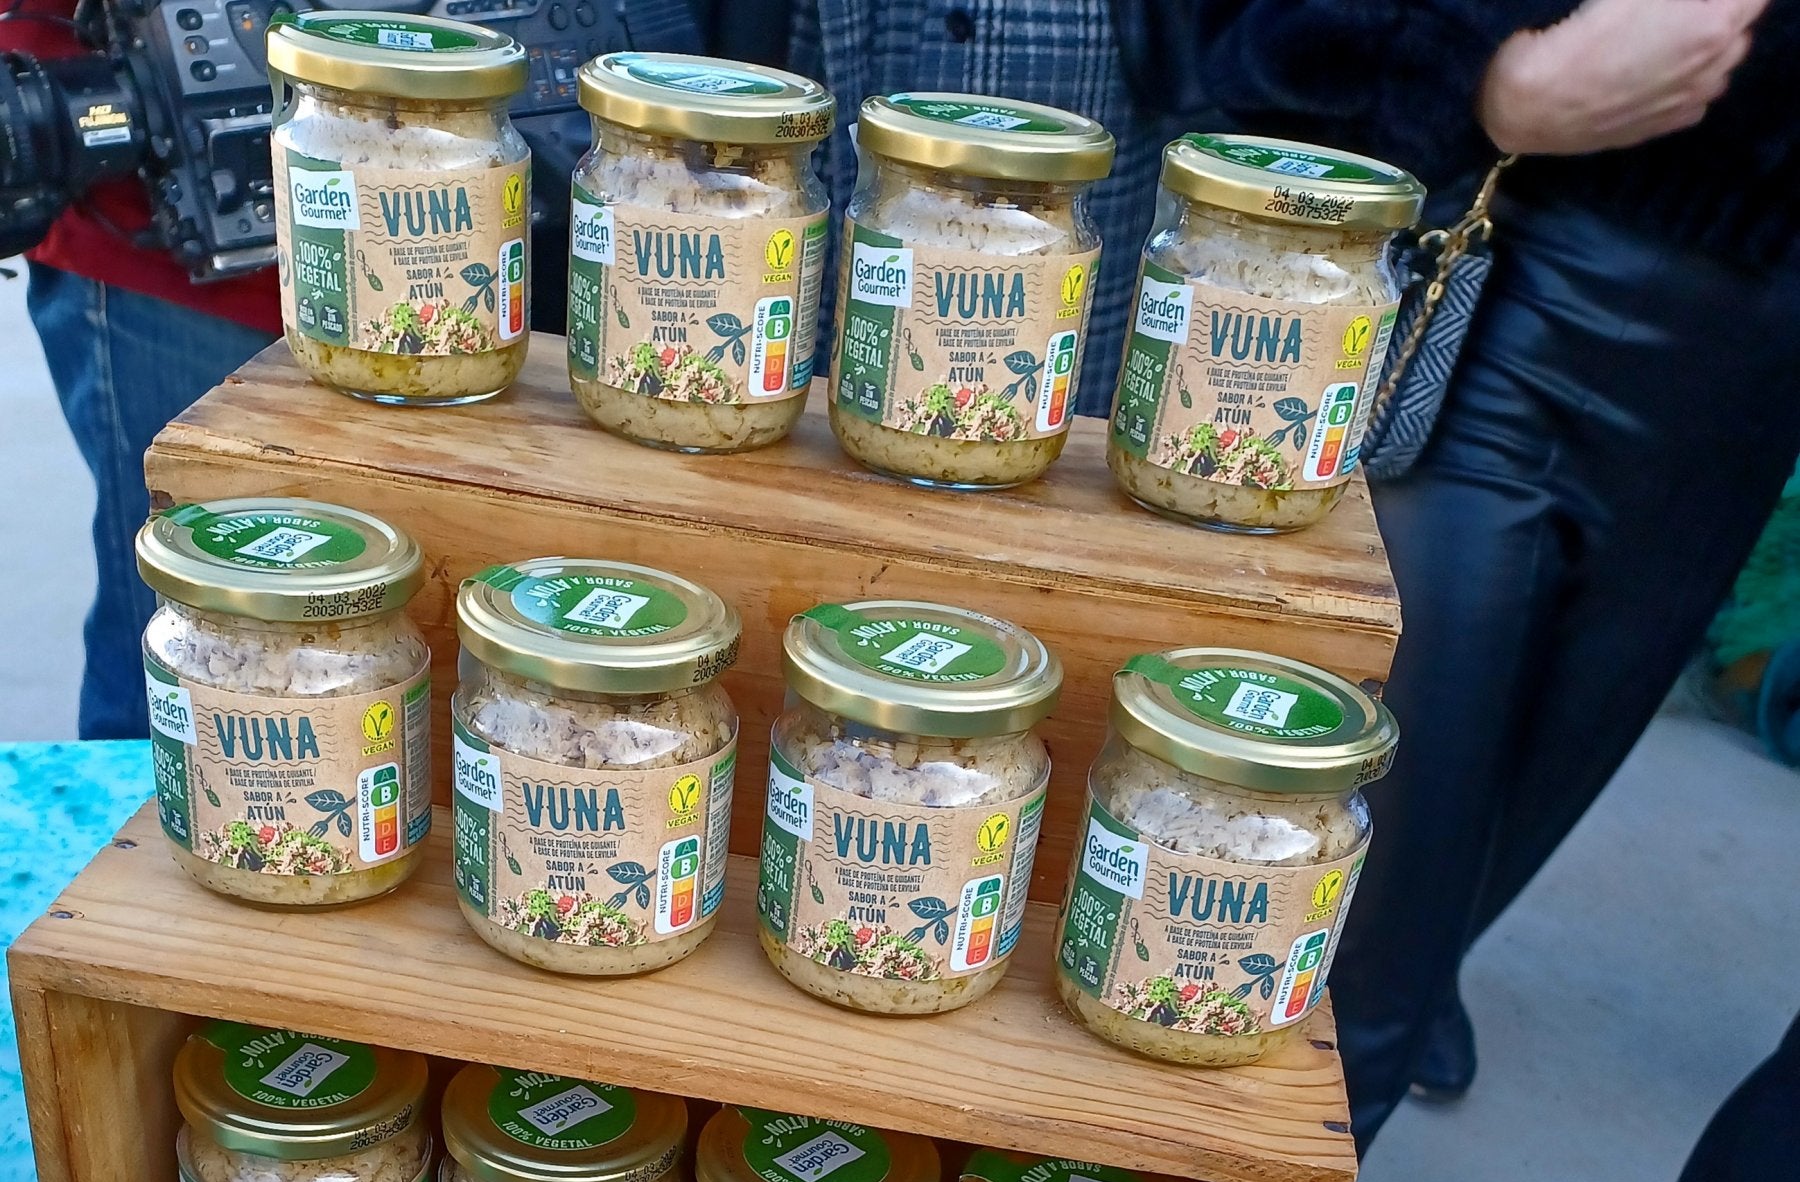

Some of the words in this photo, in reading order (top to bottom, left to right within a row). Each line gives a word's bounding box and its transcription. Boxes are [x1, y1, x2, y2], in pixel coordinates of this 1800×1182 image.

[295, 183, 350, 206] Garden
[1273, 186, 1353, 211] 04.03.2022
[301, 205, 348, 220] Gourmet
[379, 187, 473, 236] VUNA
[1265, 199, 1347, 222] 200307532E
[574, 215, 608, 241] Garden
[299, 241, 332, 269] 100%
[633, 230, 724, 279] VUNA
[296, 259, 341, 292] VEGETAL
[406, 269, 433, 280] SABOR
[436, 269, 441, 278] A
[764, 274, 791, 282] VEGAN
[856, 258, 905, 283] Garden
[410, 281, 443, 300] ATÚN
[858, 280, 901, 297] Gourmet
[935, 272, 1024, 318] VUNA
[1058, 309, 1079, 317] VEGAN
[1141, 292, 1184, 320] Garden
[651, 311, 678, 322] SABOR
[680, 313, 686, 322] A
[1141, 313, 1179, 333] Gourmet
[653, 325, 686, 342] ATÚN
[773, 321, 783, 336] B
[850, 317, 877, 346] 100%
[1211, 311, 1302, 362] VUNA
[754, 306, 765, 374] NUTRI-SCORE
[845, 336, 883, 368] VEGETAL
[949, 352, 975, 362] SABOR
[979, 353, 984, 362] A
[1060, 354, 1068, 370] B
[1337, 360, 1361, 368] VEGAN
[949, 363, 983, 382] ATÚN
[1217, 392, 1246, 404] SABOR
[1247, 395, 1253, 405] A
[1215, 407, 1251, 425] ATÚN
[1336, 406, 1346, 423] B
[586, 577, 634, 588] SABOR
[308, 583, 386, 604] 04.03.2022
[303, 597, 382, 618] 200307532E
[913, 622, 960, 635] SABOR
[1230, 670, 1277, 684] SABOR
[214, 714, 320, 760] VUNA
[363, 742, 394, 754] VEGAN
[456, 752, 496, 788] Garden
[243, 791, 274, 802] SABOR
[276, 792, 282, 802] A
[381, 788, 391, 802] B
[769, 779, 807, 815] Garden
[247, 803, 285, 821] ATÚN
[361, 778, 370, 841] NUTRI-SCORE
[522, 783, 625, 831] VUNA
[668, 815, 699, 827] VEGAN
[547, 839, 554, 848] DE
[583, 841, 589, 849] DE
[834, 813, 931, 865] VUNA
[552, 849, 559, 857] DE
[587, 850, 593, 858] DE
[973, 854, 1004, 865] VEGAN
[1089, 836, 1139, 874] Garden
[546, 860, 576, 872] SABOR
[578, 862, 584, 872] A
[681, 859, 690, 871] B
[1090, 858, 1132, 887] Gourmet
[548, 873, 585, 891] ATÚN
[660, 850, 671, 913] NUTRI-SCORE
[848, 891, 878, 903] SABOR
[879, 895, 886, 904] A
[982, 898, 992, 910] B
[1078, 888, 1104, 924] 100%
[1168, 872, 1269, 924] VUNA
[848, 905, 885, 924] ATÚN
[958, 888, 973, 950] NUTRI-SCORE
[1305, 908, 1332, 922] VEGAN
[1070, 906, 1108, 948] VEGETAL
[1177, 949, 1208, 962] SABOR
[1210, 952, 1216, 962] A
[1306, 955, 1315, 968] B
[1174, 962, 1214, 980] ATÚN
[1278, 944, 1301, 1004] NUTRI-SCORE
[281, 1052, 333, 1088] Garden
[252, 1090, 286, 1105] 100%
[292, 1093, 349, 1107] VEGETAL
[536, 1095, 598, 1125] Garden
[502, 1121, 530, 1140] 100%
[535, 1137, 592, 1148] VEGETAL
[796, 1142, 849, 1173] Garden
